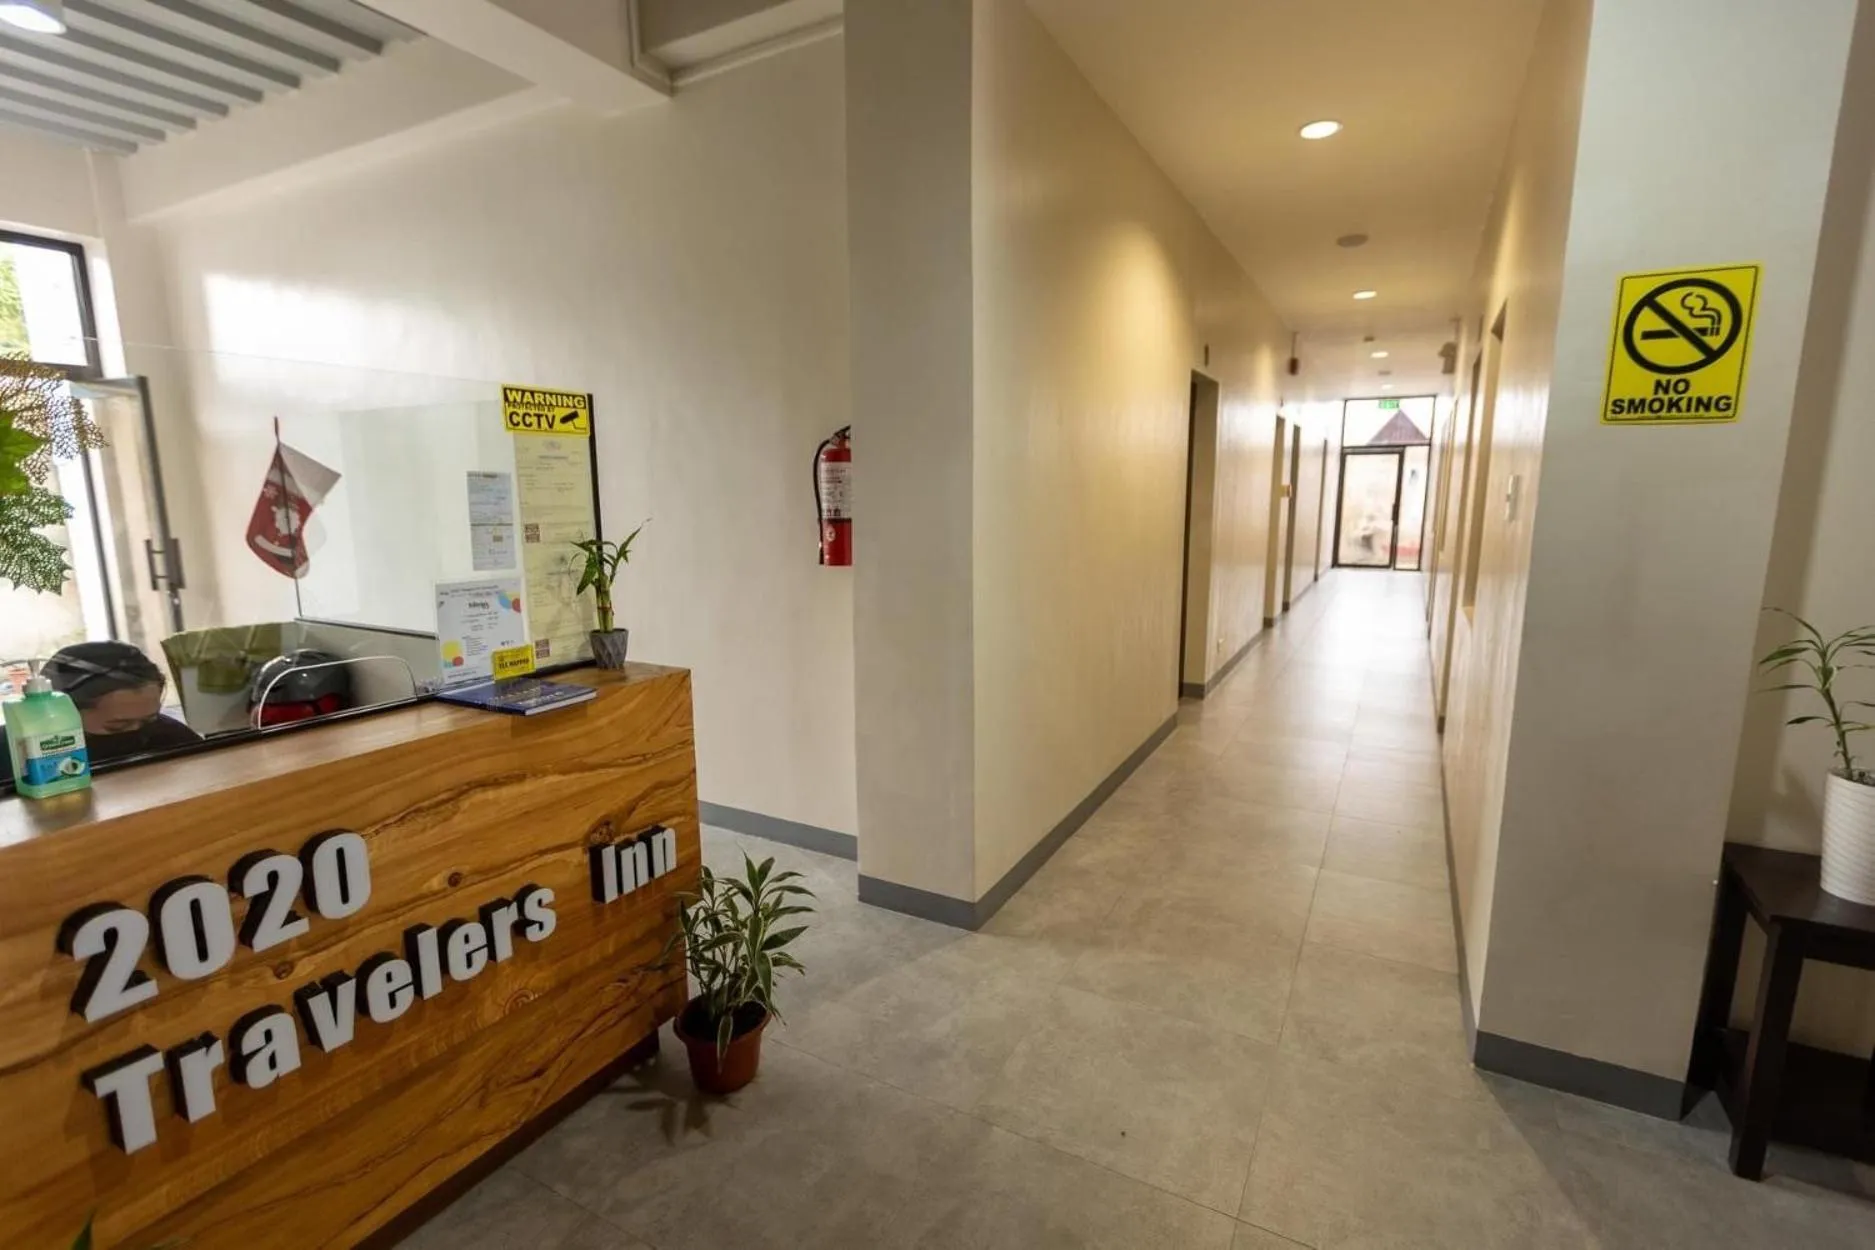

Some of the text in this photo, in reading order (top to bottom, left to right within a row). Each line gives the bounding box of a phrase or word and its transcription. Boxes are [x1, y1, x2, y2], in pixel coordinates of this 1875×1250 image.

[1654, 378, 1691, 396] NO
[506, 389, 585, 409] WARNING
[1610, 395, 1732, 415] SMOKING
[509, 411, 556, 430] CCTV
[62, 828, 372, 1024] 2020
[86, 826, 677, 1156] Travelers Inn
